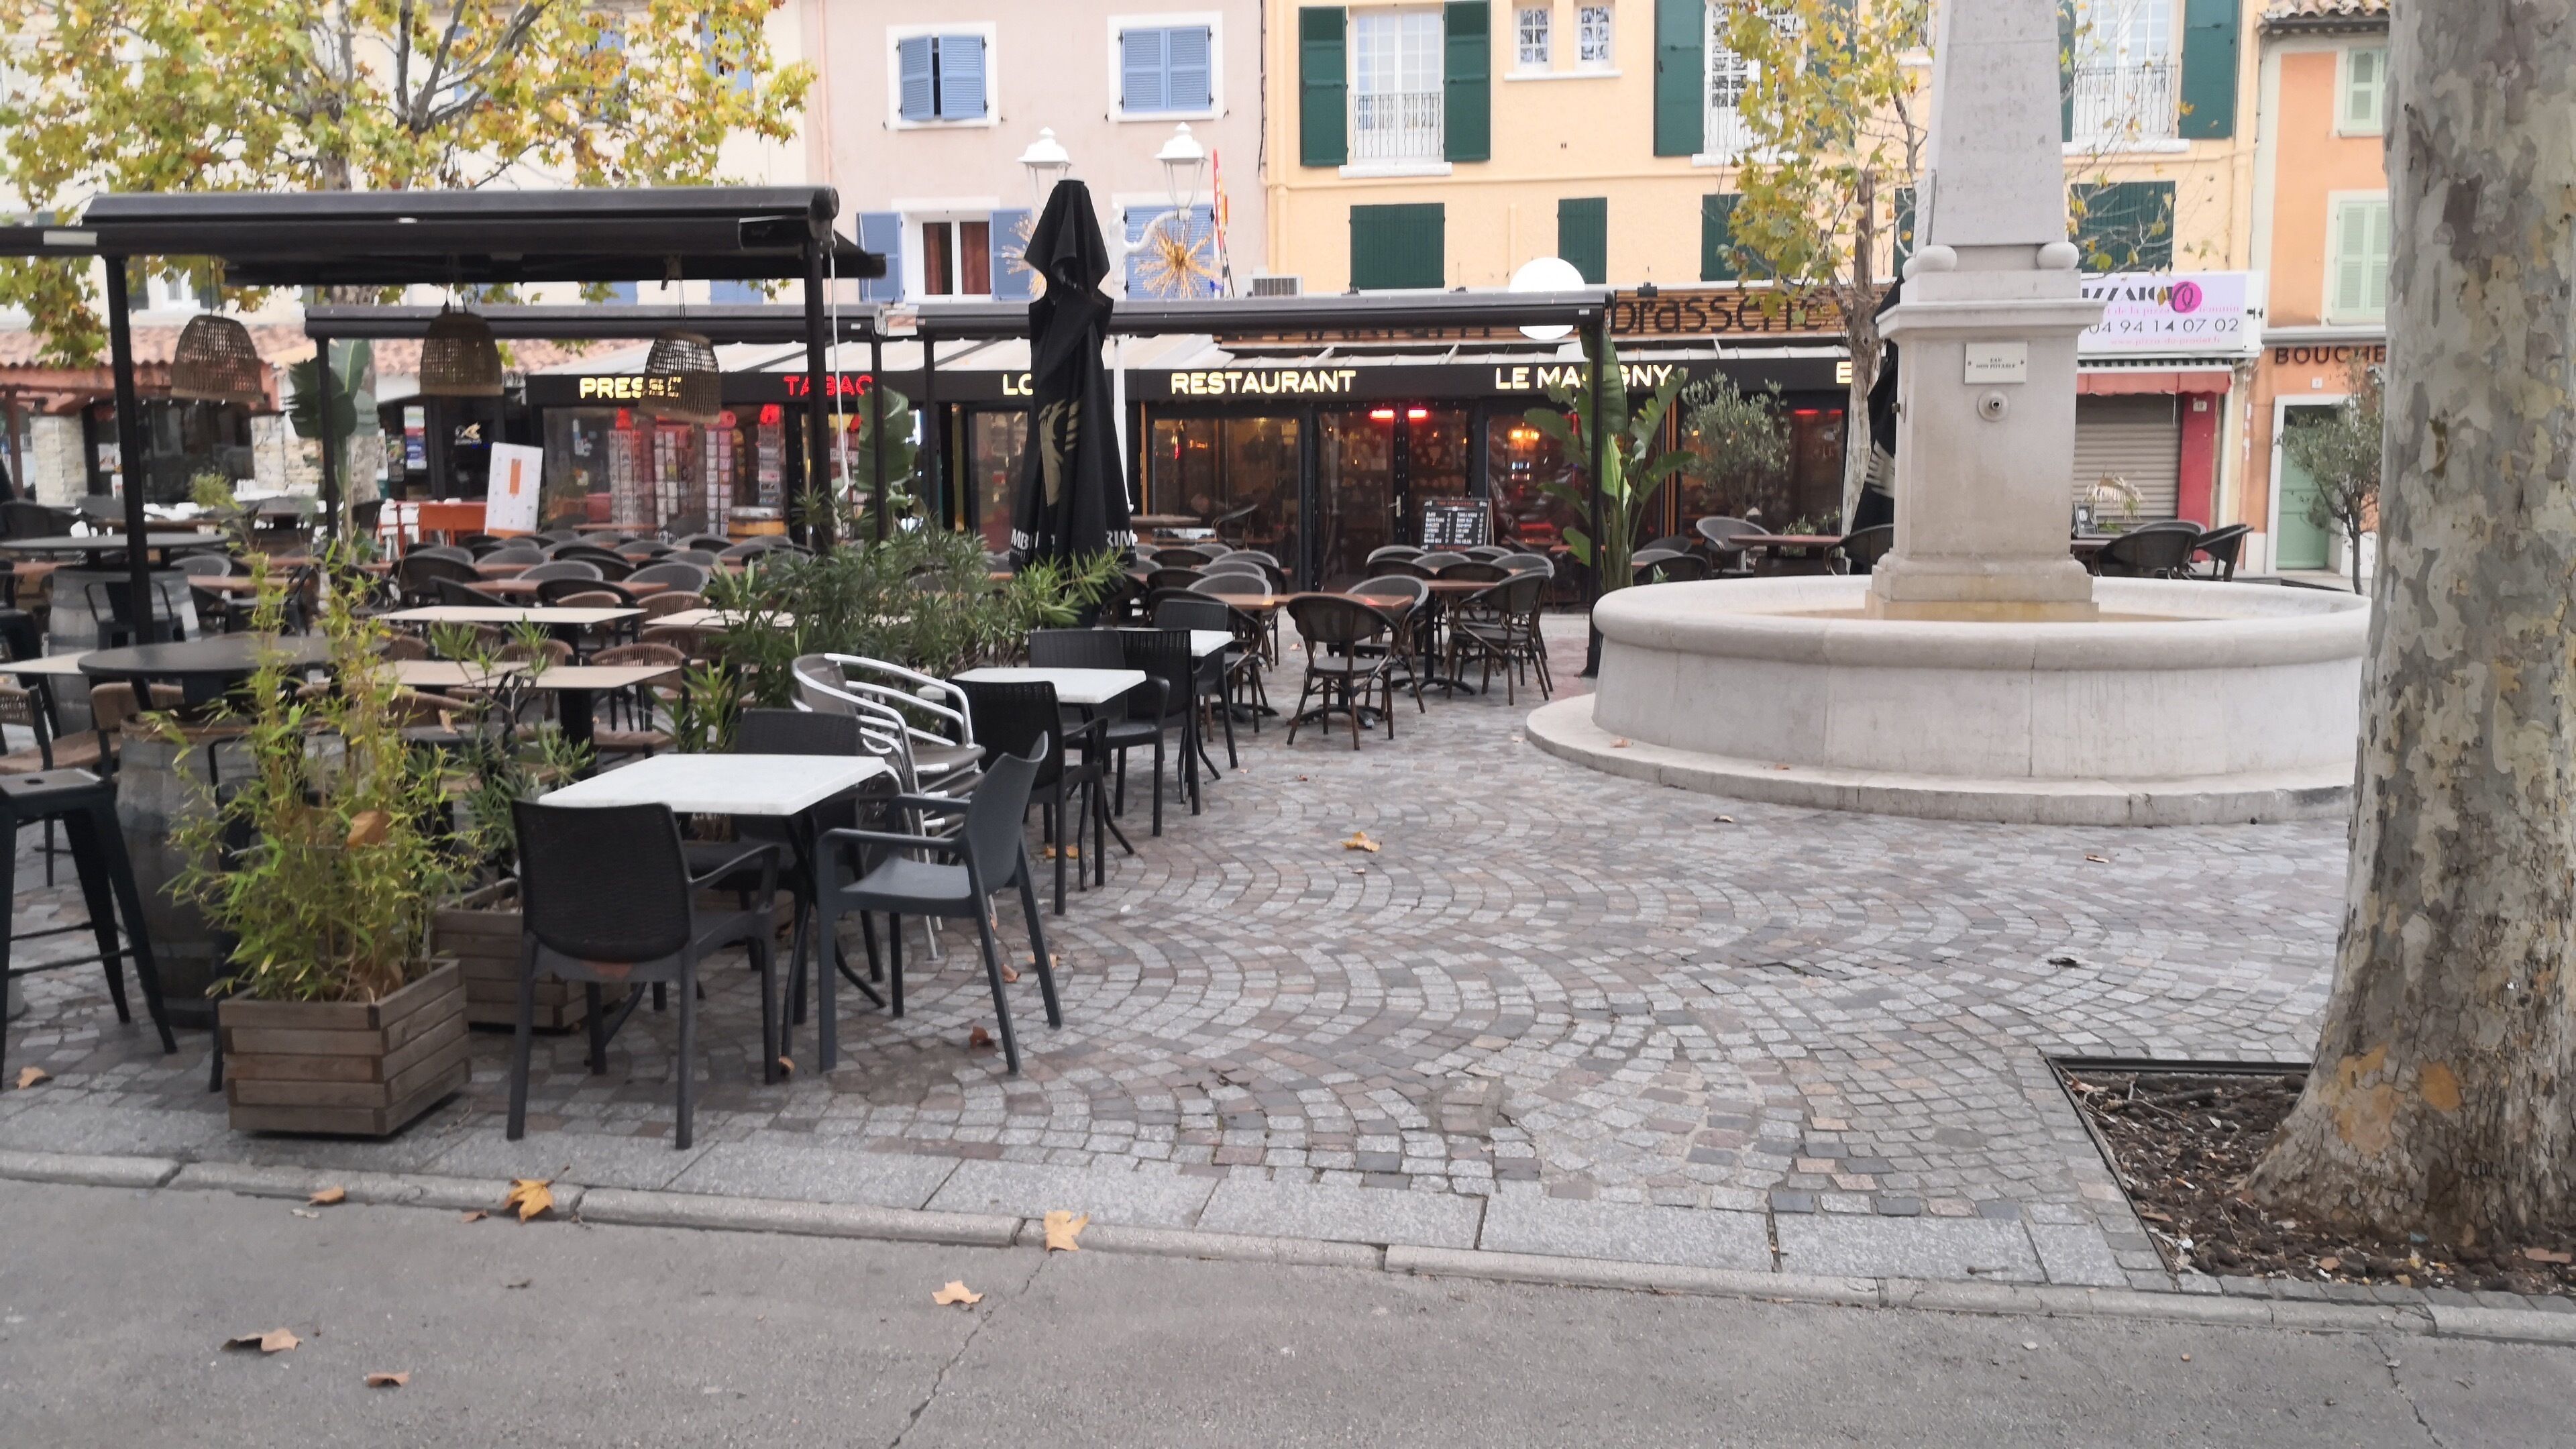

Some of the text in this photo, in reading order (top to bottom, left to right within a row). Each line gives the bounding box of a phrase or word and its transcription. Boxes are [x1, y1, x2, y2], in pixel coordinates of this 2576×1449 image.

[2088, 318, 2239, 334] 04 94 14 07 02
[1171, 370, 1356, 395] RESTAURANT
[1496, 365, 1672, 389] LE MAGNY
